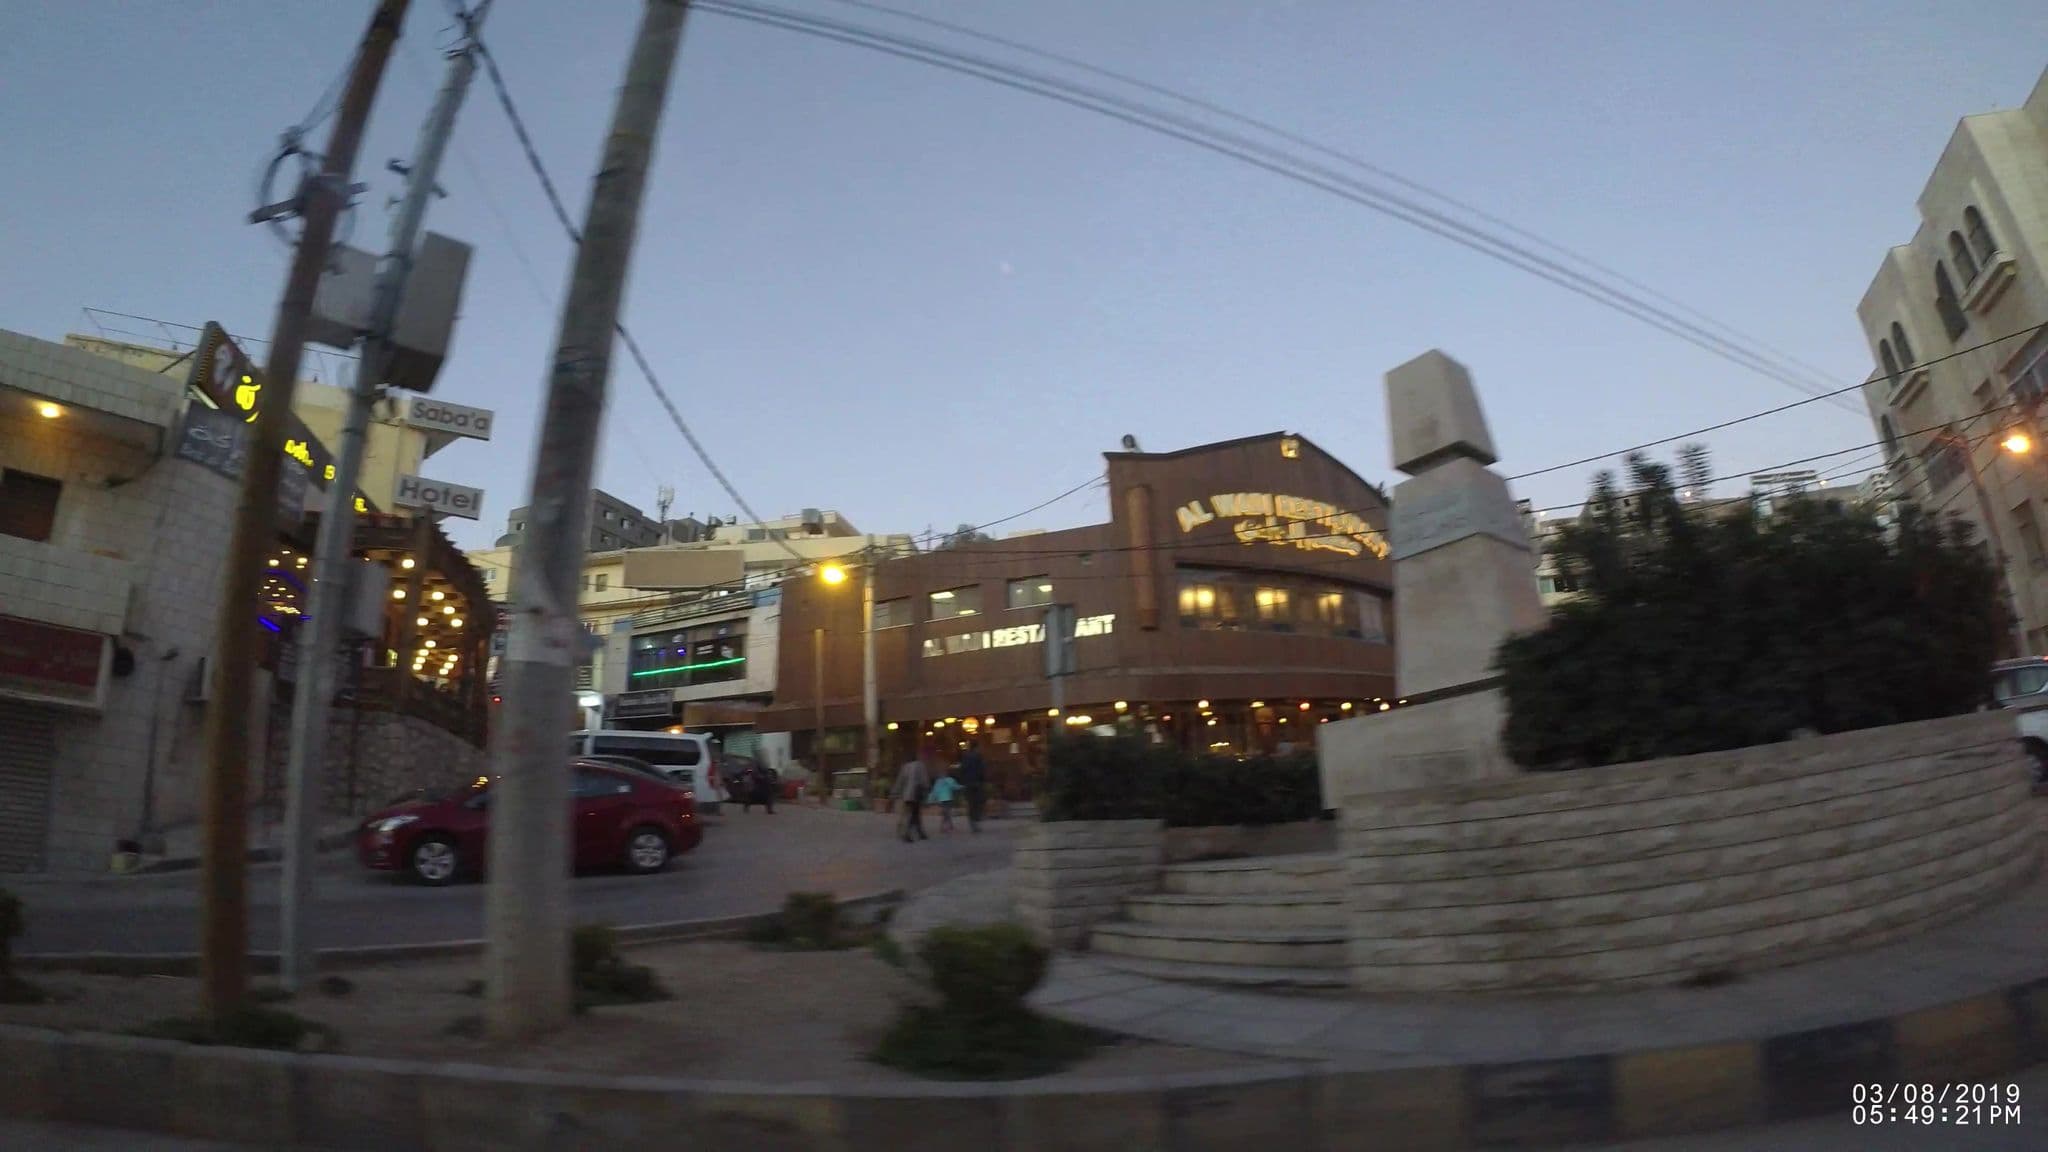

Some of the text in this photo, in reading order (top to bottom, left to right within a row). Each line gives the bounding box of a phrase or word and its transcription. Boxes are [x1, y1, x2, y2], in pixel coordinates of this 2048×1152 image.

[412, 402, 490, 431] Saba'a
[401, 477, 479, 511] Hotel
[1176, 500, 1214, 533] AL
